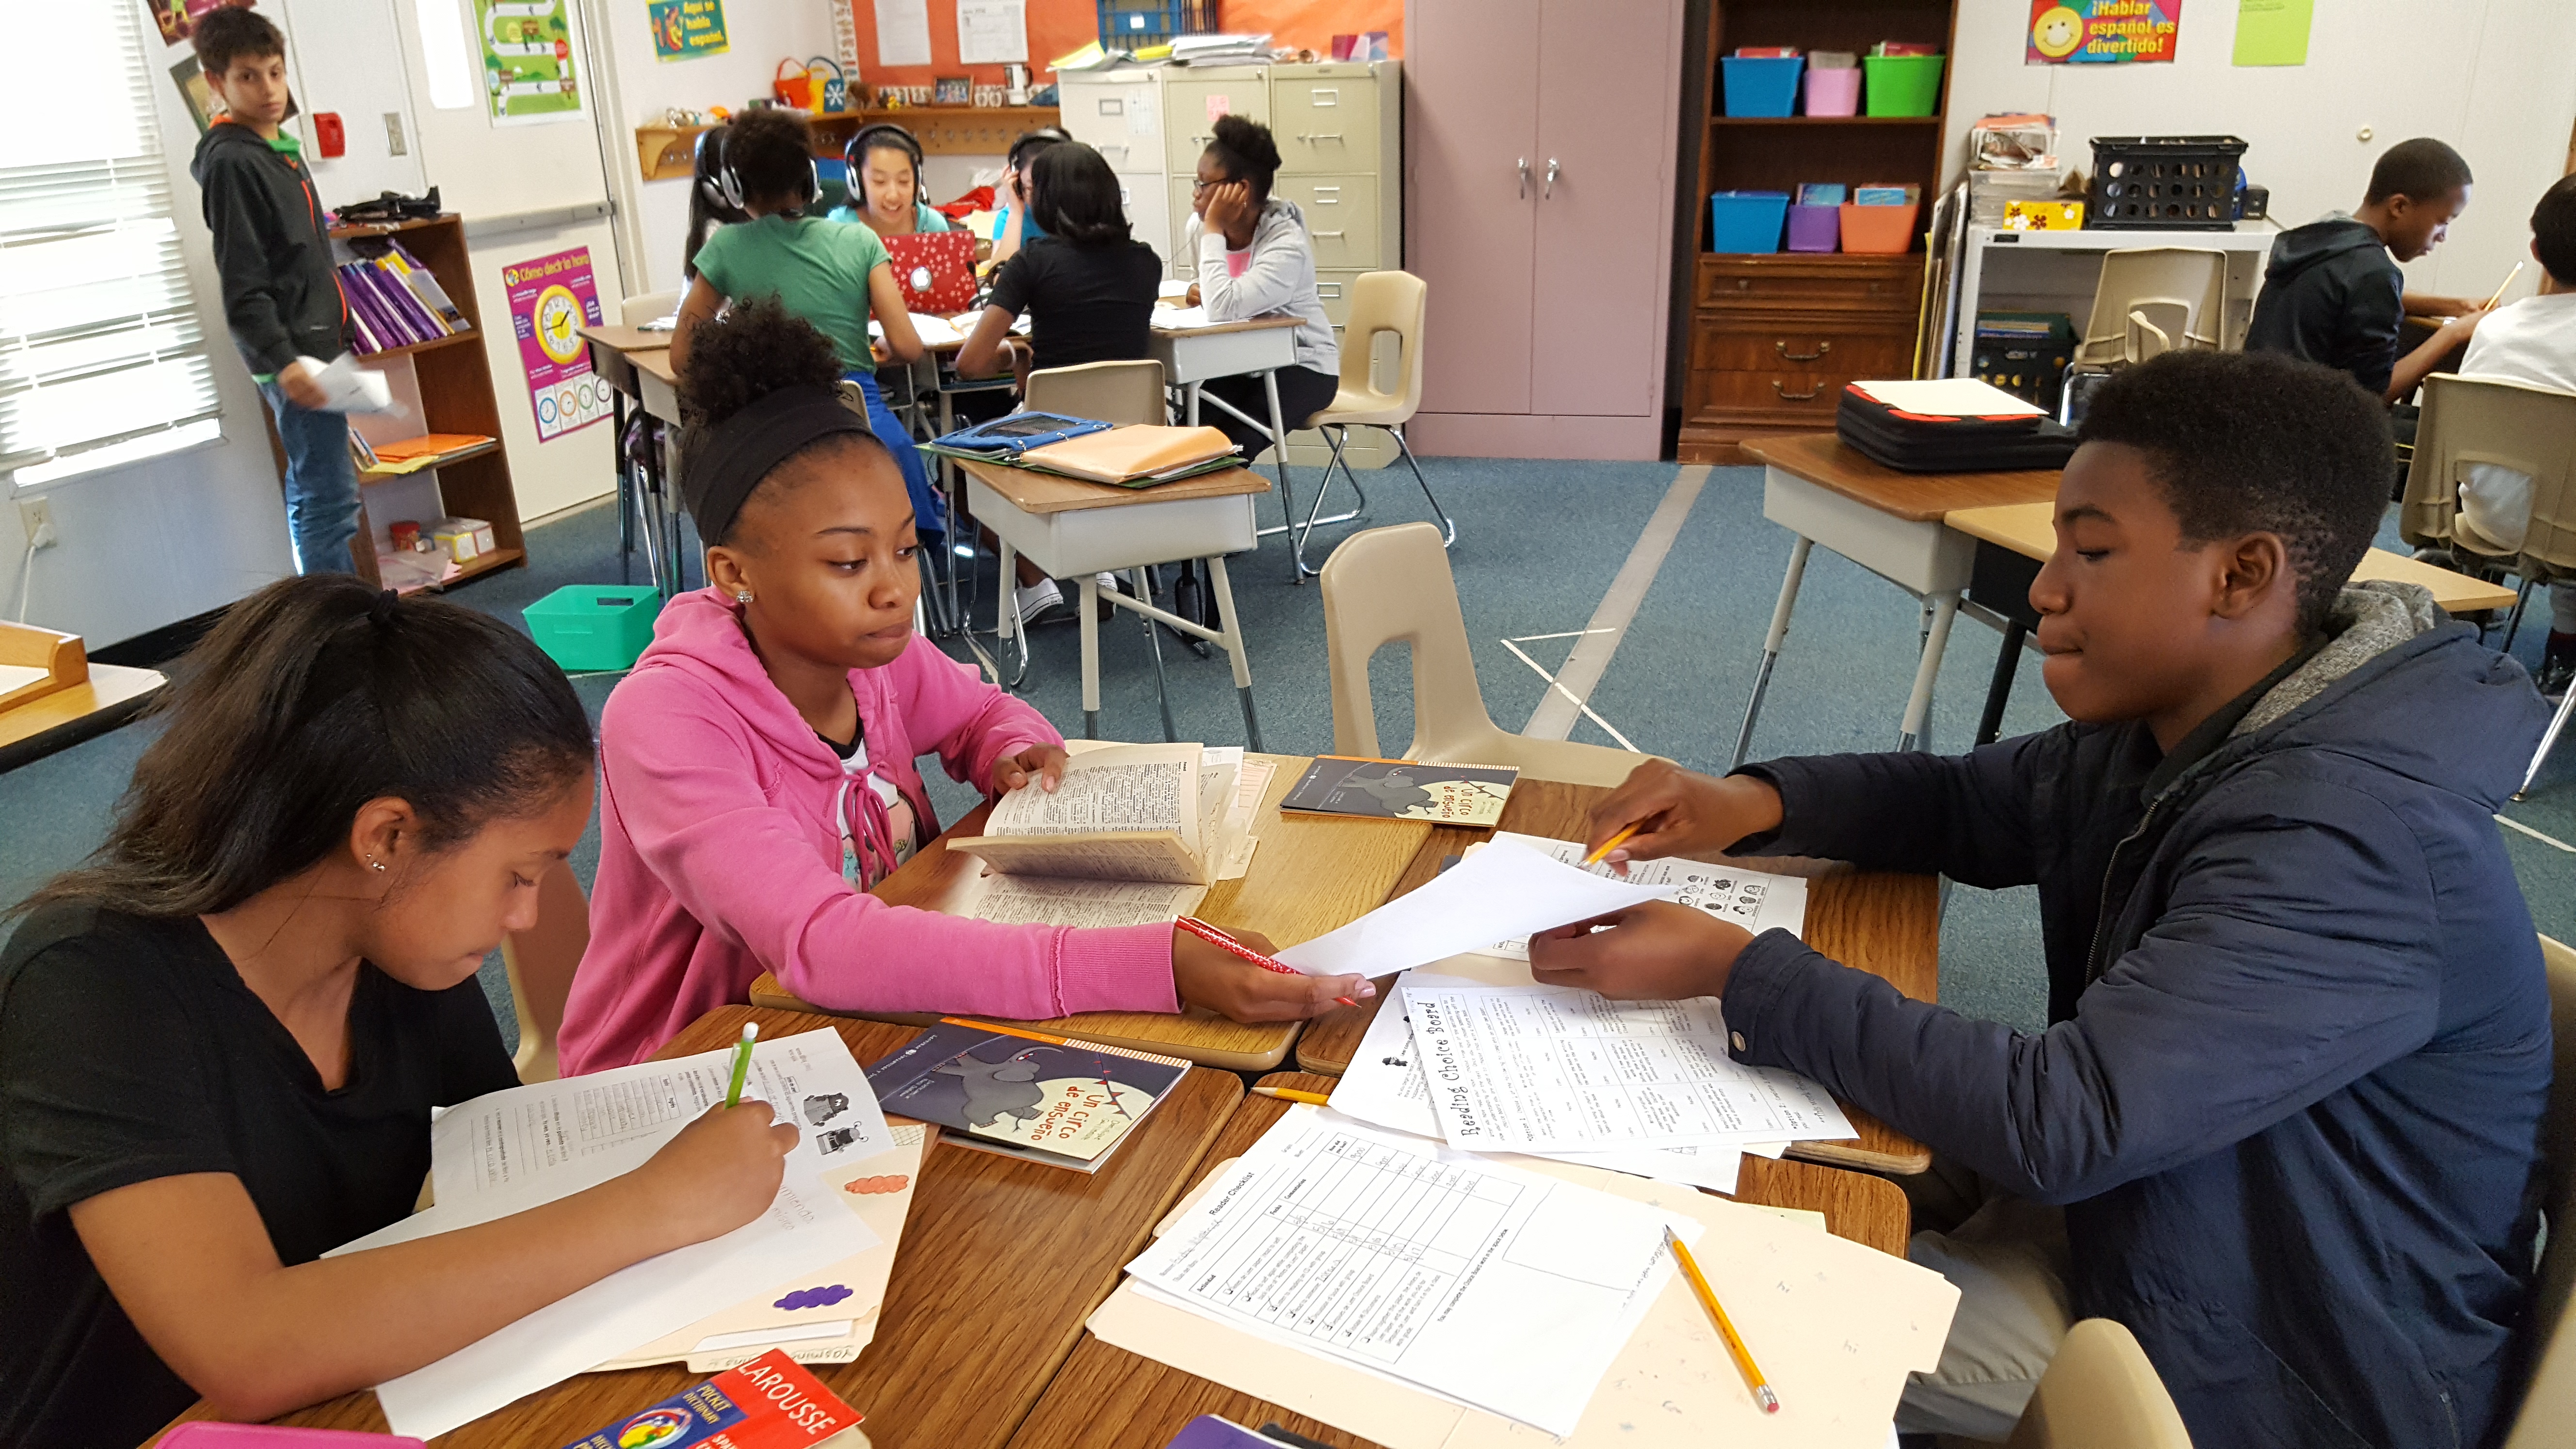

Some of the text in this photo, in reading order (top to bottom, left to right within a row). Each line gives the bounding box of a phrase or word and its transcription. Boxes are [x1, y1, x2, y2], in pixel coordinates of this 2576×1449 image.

[684, 0, 715, 15] Aquí se
[2091, 0, 2152, 16] ¡Hablar
[686, 16, 711, 30] habla
[2089, 20, 2175, 38] español es
[2087, 38, 2163, 54] divertido!
[519, 267, 544, 281] Cómo
[544, 260, 563, 276] decir
[571, 255, 590, 267] hora
[1441, 795, 1461, 818] ensueño
[1453, 799, 1473, 815] circo
[1417, 1002, 1480, 1135] Reading Choice Board
[1031, 1086, 1085, 1140] de ensueño
[1083, 1095, 1104, 1108] Un
[1059, 1111, 1089, 1139] circo
[1209, 1172, 1254, 1215] Reader Checklist
[1197, 1274, 1216, 1292] Actividad
[1270, 1205, 1282, 1215] Fecha
[1284, 1179, 1306, 1199] Comentarios
[683, 1392, 720, 1425] DICTIONARY
[696, 1385, 732, 1412] POCKET
[738, 1357, 837, 1434] LAROUSSE
